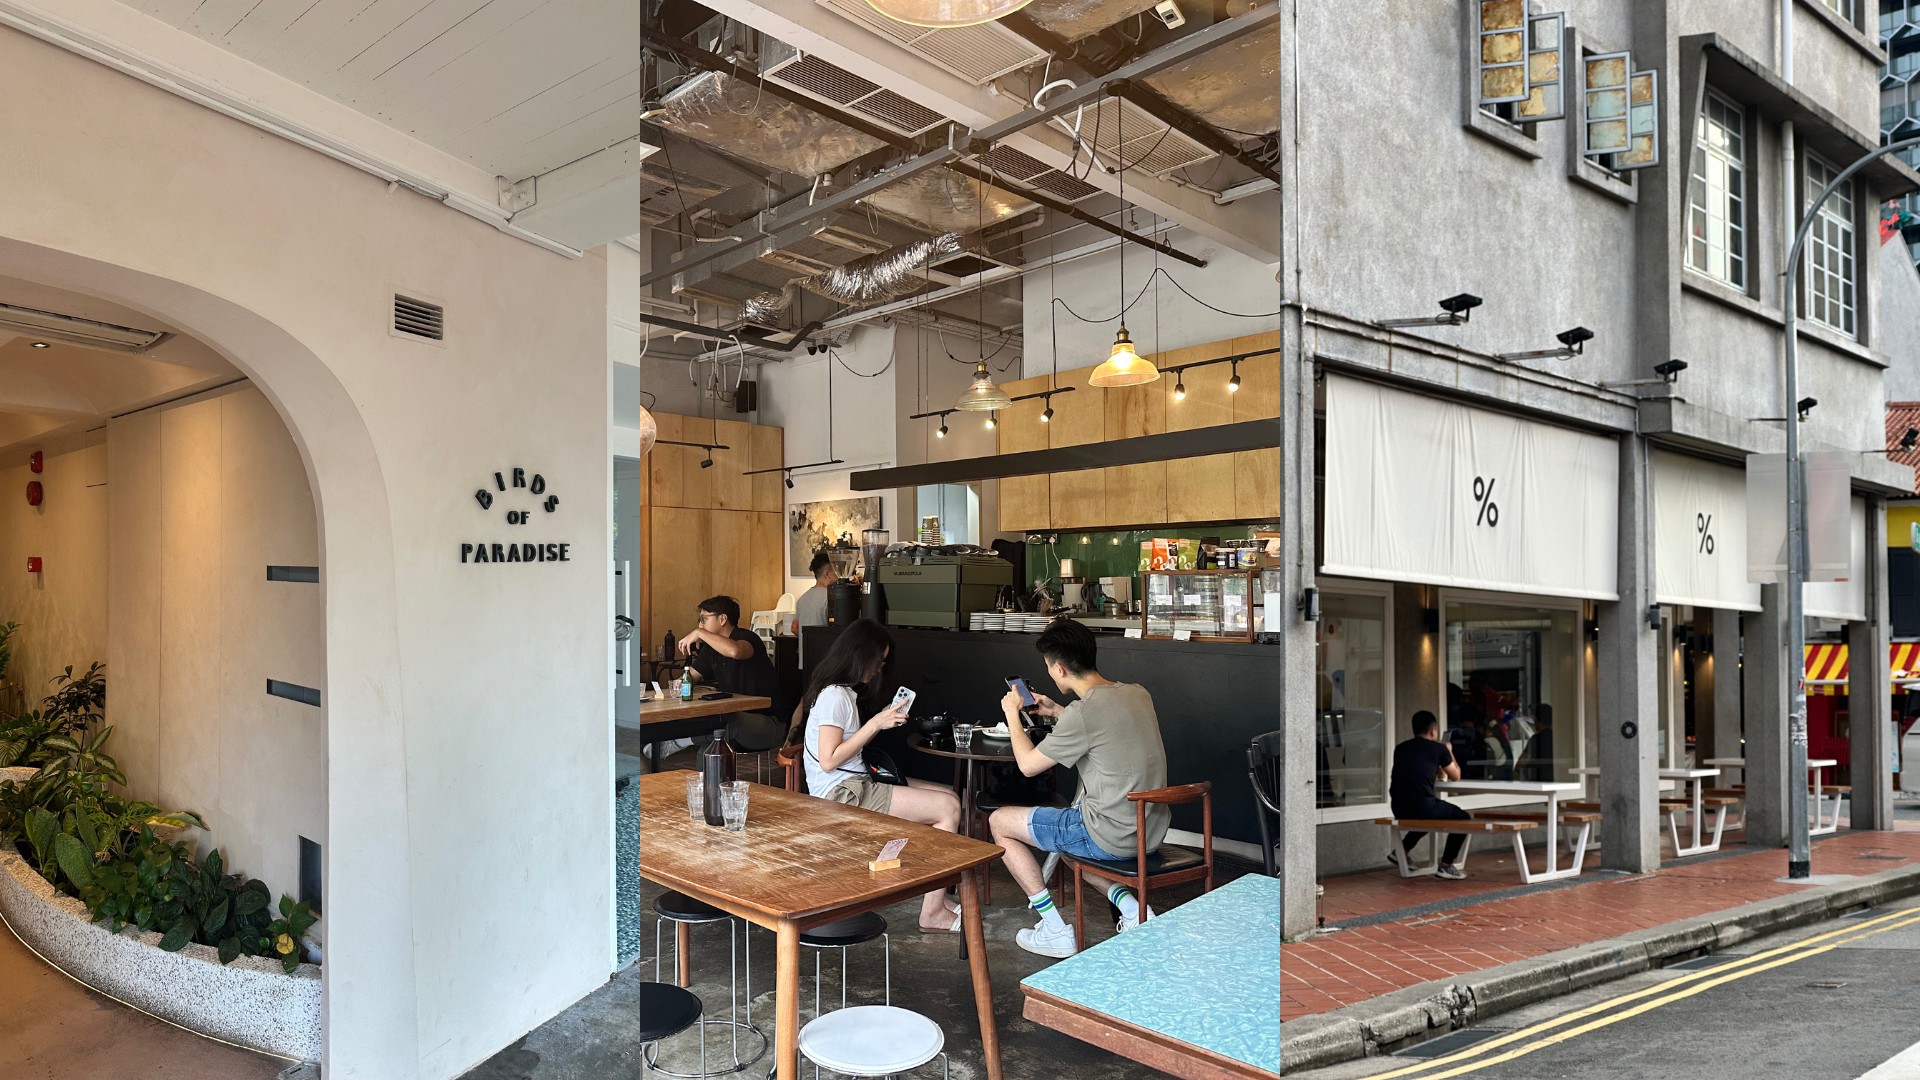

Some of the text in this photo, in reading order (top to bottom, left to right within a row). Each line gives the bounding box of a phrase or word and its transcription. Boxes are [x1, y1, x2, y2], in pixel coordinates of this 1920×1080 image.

[475, 468, 560, 513] BIRDS
[1474, 477, 1498, 527] %
[507, 511, 530, 525] OF
[1698, 513, 1713, 554] %
[462, 544, 570, 563] PARADISE
